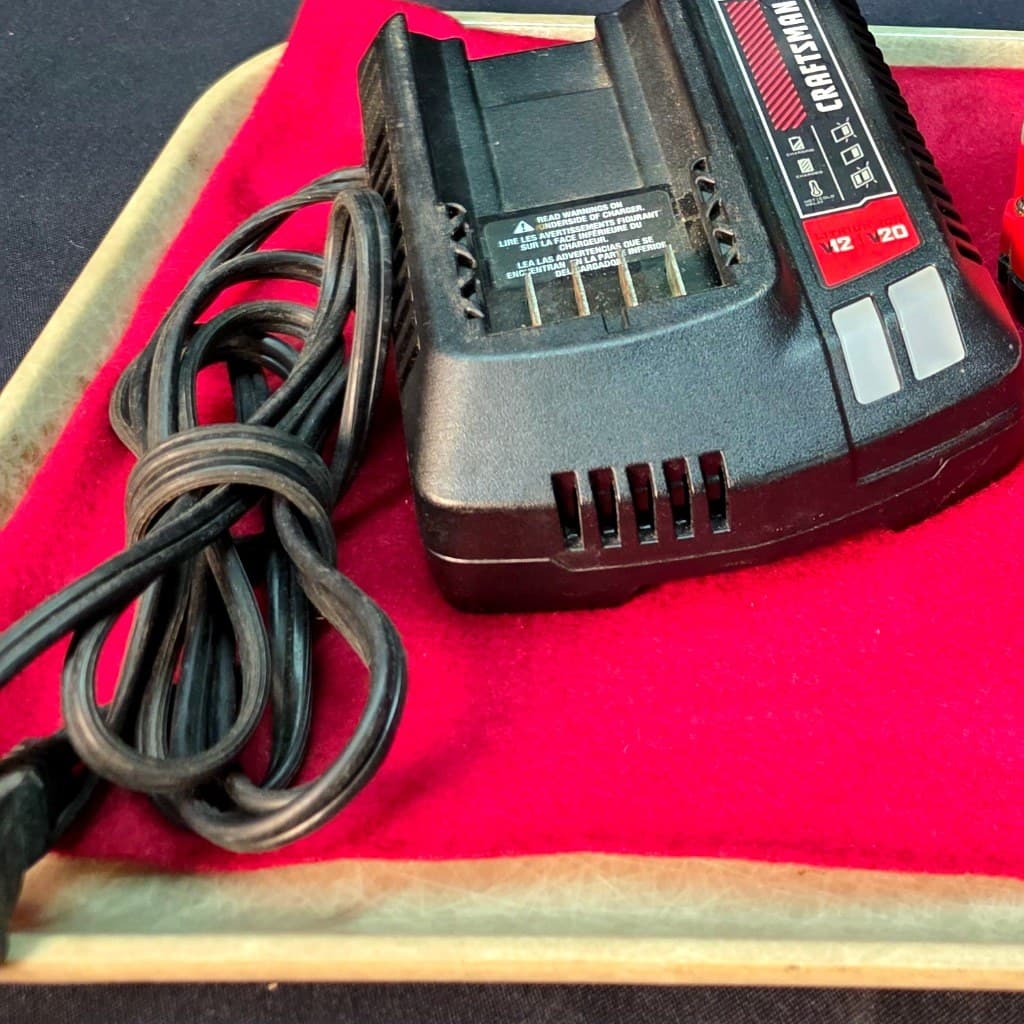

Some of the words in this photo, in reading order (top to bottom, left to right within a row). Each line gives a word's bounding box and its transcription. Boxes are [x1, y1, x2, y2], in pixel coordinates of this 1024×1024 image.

[771, 0, 843, 113] CRAFTSMAN
[537, 213, 560, 223] READ
[562, 203, 608, 218] WARNINGS
[610, 201, 623, 209] ON
[589, 212, 600, 220] OF
[602, 204, 645, 218] CHARGER.
[499, 237, 518, 247] LIRE
[521, 234, 537, 242] LES
[539, 219, 615, 239] AVERTISSEMENTS
[618, 210, 659, 224] FIGURANT
[521, 241, 538, 251] SUR
[541, 238, 552, 246] LA
[554, 234, 576, 244] FACE
[630, 221, 642, 229] DU
[517, 259, 534, 269] LEA
[537, 255, 554, 264] LAS
[556, 242, 622, 261] ADVERTENCIAS
[624, 238, 640, 247] QUE
[642, 235, 654, 244] SE
[559, 235, 609, 251] CHARGEUR.
[507, 261, 565, 279] ENCENTRAN
[585, 255, 596, 263] LA
